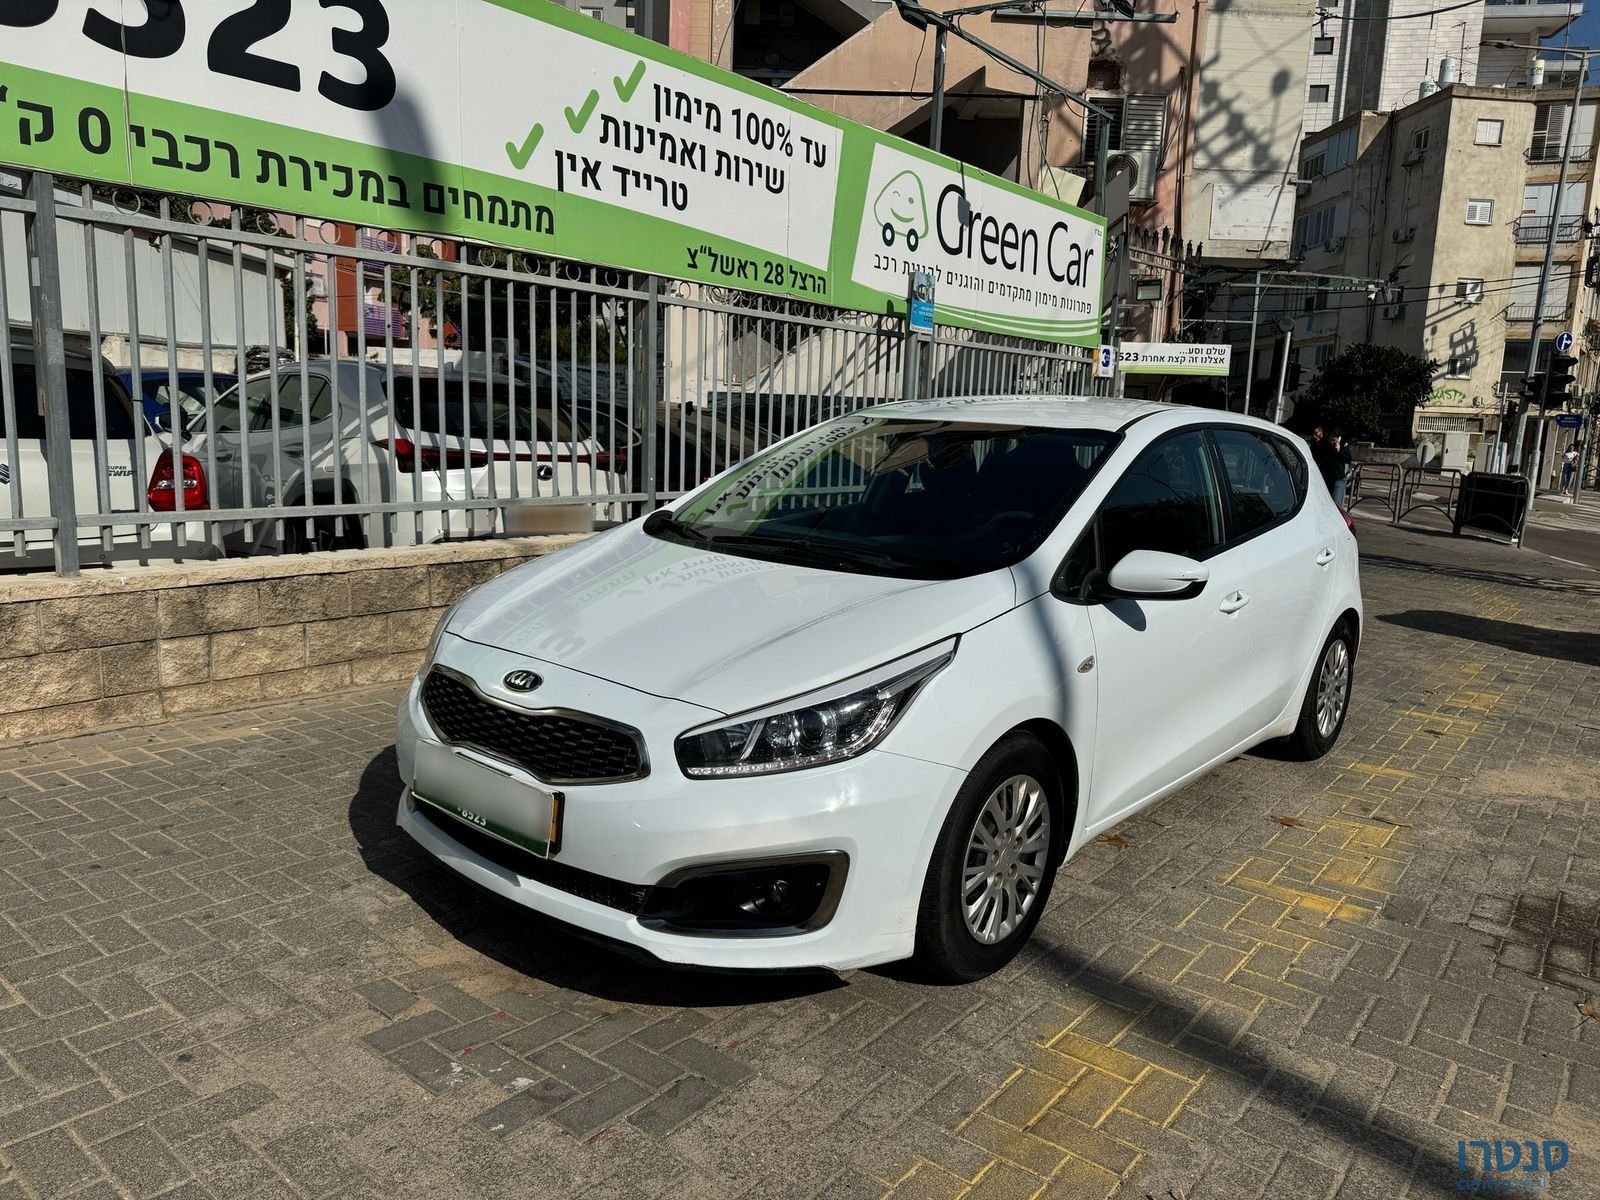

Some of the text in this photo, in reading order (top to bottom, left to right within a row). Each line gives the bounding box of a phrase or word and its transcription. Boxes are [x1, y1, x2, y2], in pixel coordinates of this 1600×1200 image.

[78, 106, 111, 155] 0
[654, 84, 827, 168] עד 100% מימון
[130, 125, 241, 179] רכבי
[600, 114, 785, 195] שירות ואמינות
[257, 149, 411, 209] במכירת
[554, 150, 688, 211] טרייד אין
[423, 181, 555, 235] מתמחים
[936, 184, 1095, 288] Green Car
[763, 261, 784, 286] 28
[873, 254, 897, 273] רכב
[790, 265, 827, 295] הרצל
[946, 272, 984, 291] והוגנים
[988, 281, 1032, 302] מתקדמים
[1035, 291, 1058, 308] מימון
[1060, 297, 1092, 315] פתרונות
[1141, 355, 1166, 363] אחרת
[1167, 355, 1186, 365] קצת
[1188, 356, 1199, 364] זה
[1200, 356, 1226, 364] אצלנו
[1205, 346, 1226, 356] שלם
